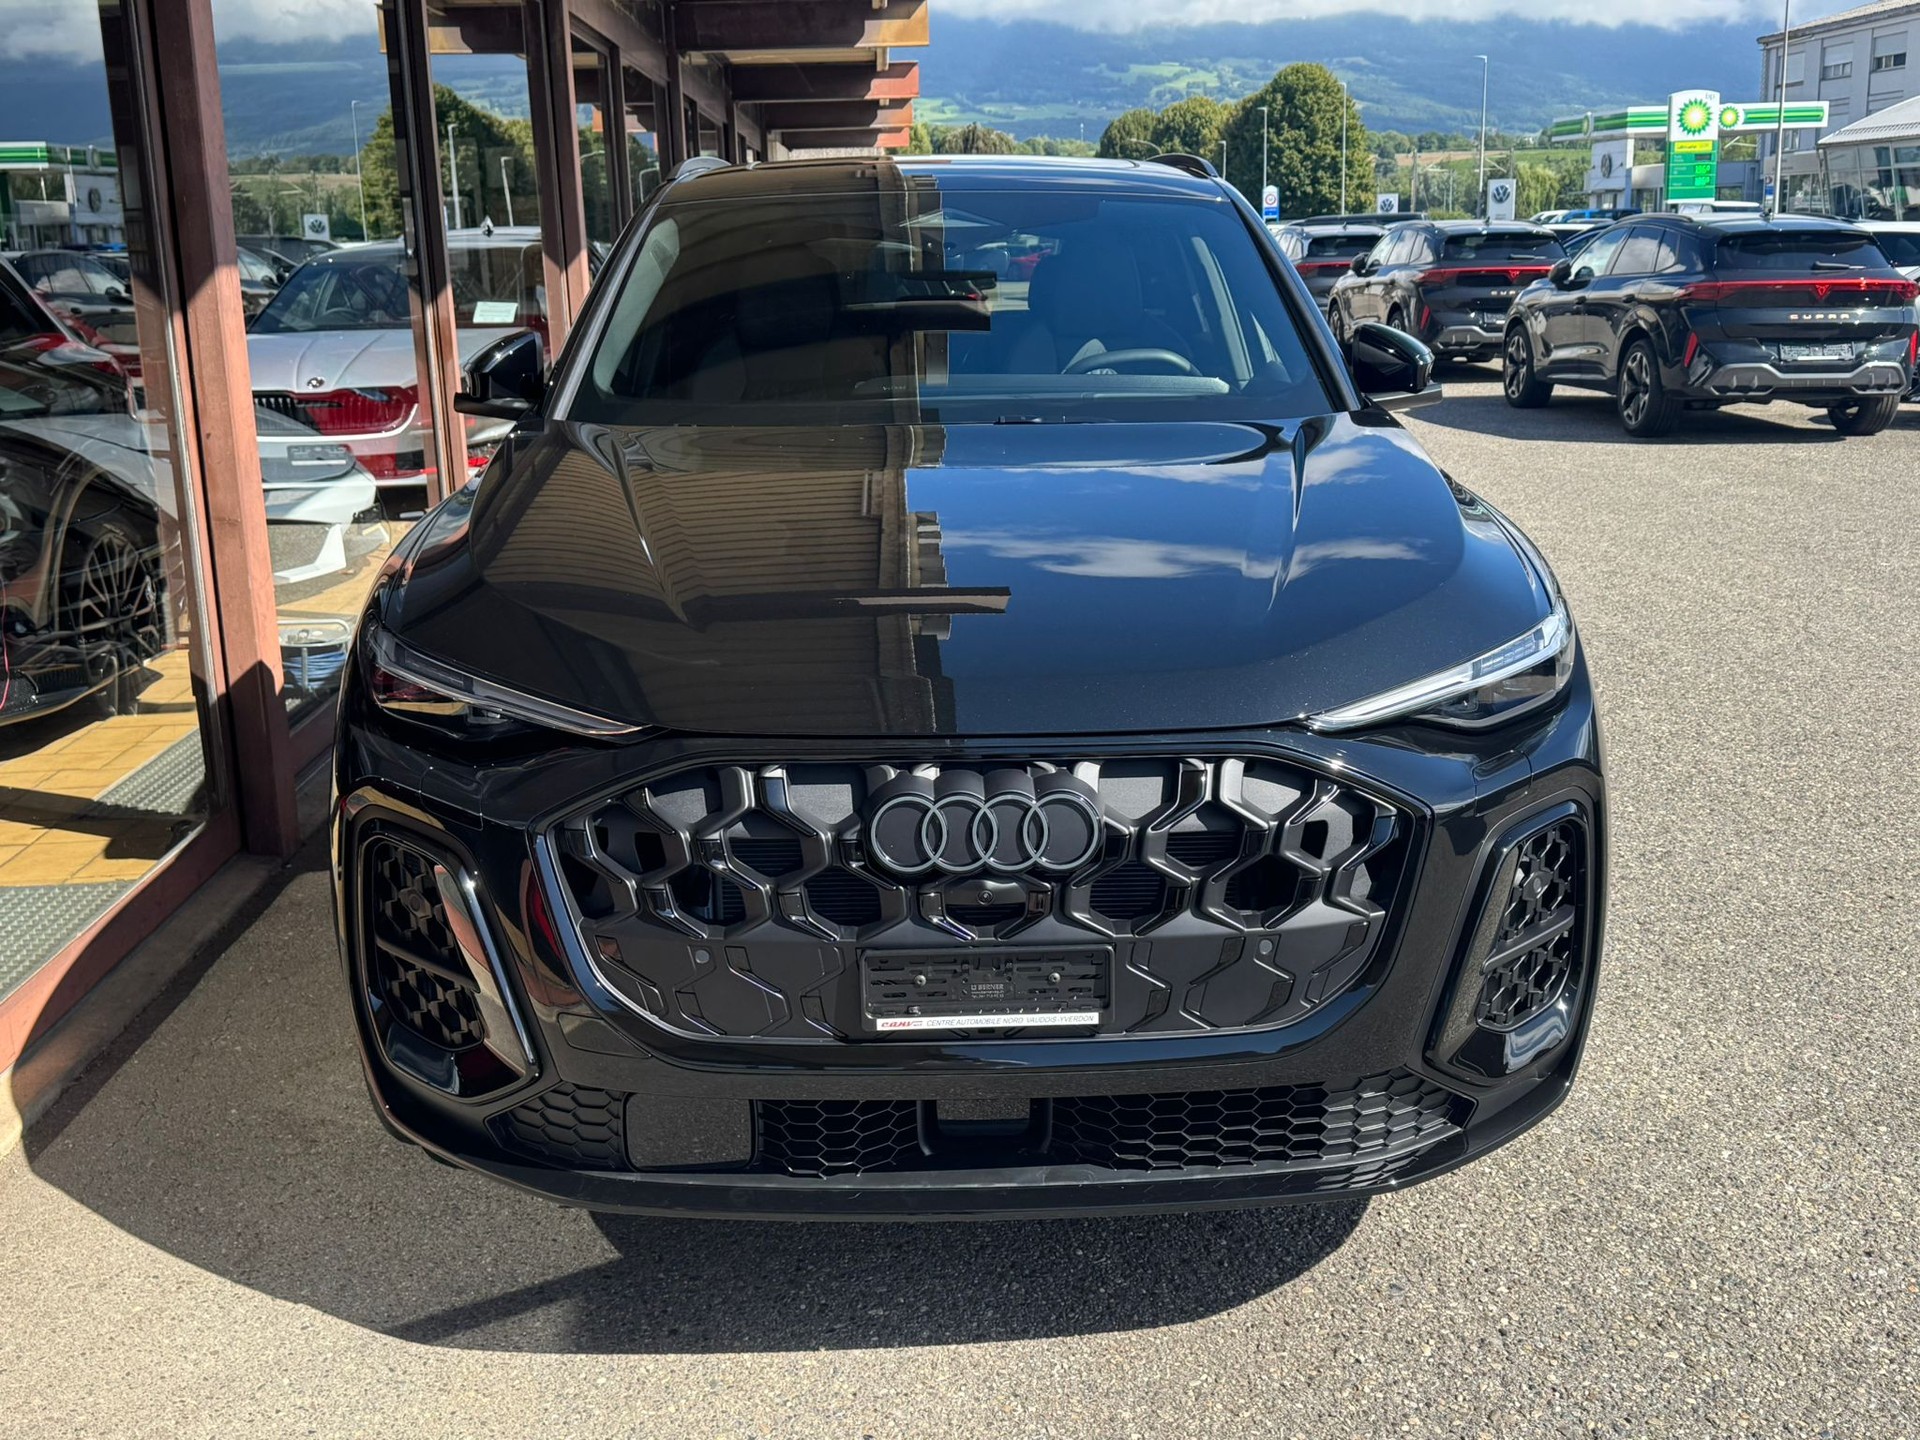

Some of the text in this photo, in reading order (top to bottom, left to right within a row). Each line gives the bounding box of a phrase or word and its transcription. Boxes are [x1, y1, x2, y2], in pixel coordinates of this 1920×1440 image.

[926, 1019, 956, 1027] CENTRE
[956, 1017, 1001, 1026] AUTOMOBILE
[1002, 1016, 1024, 1024] NORD
